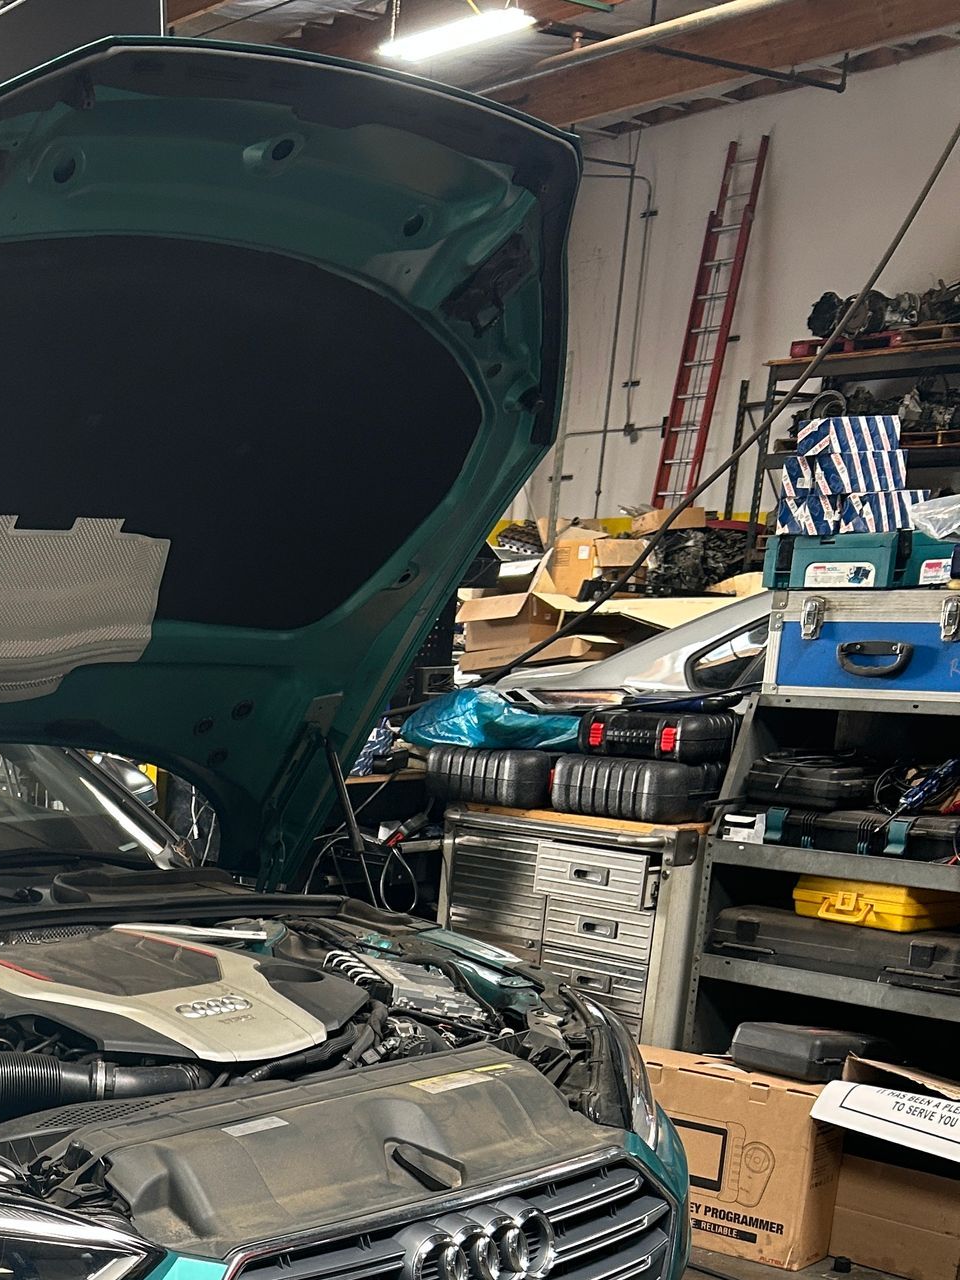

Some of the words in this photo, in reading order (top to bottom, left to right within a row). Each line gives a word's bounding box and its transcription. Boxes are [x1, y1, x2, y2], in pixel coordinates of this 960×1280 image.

[887, 1090, 906, 1100] HAS
[907, 1095, 933, 1106] BEEN
[891, 1101, 905, 1112] TO
[906, 1105, 937, 1121] SERVE
[938, 1113, 959, 1127] YOU
[703, 1206, 784, 1236] PROGRAMMER
